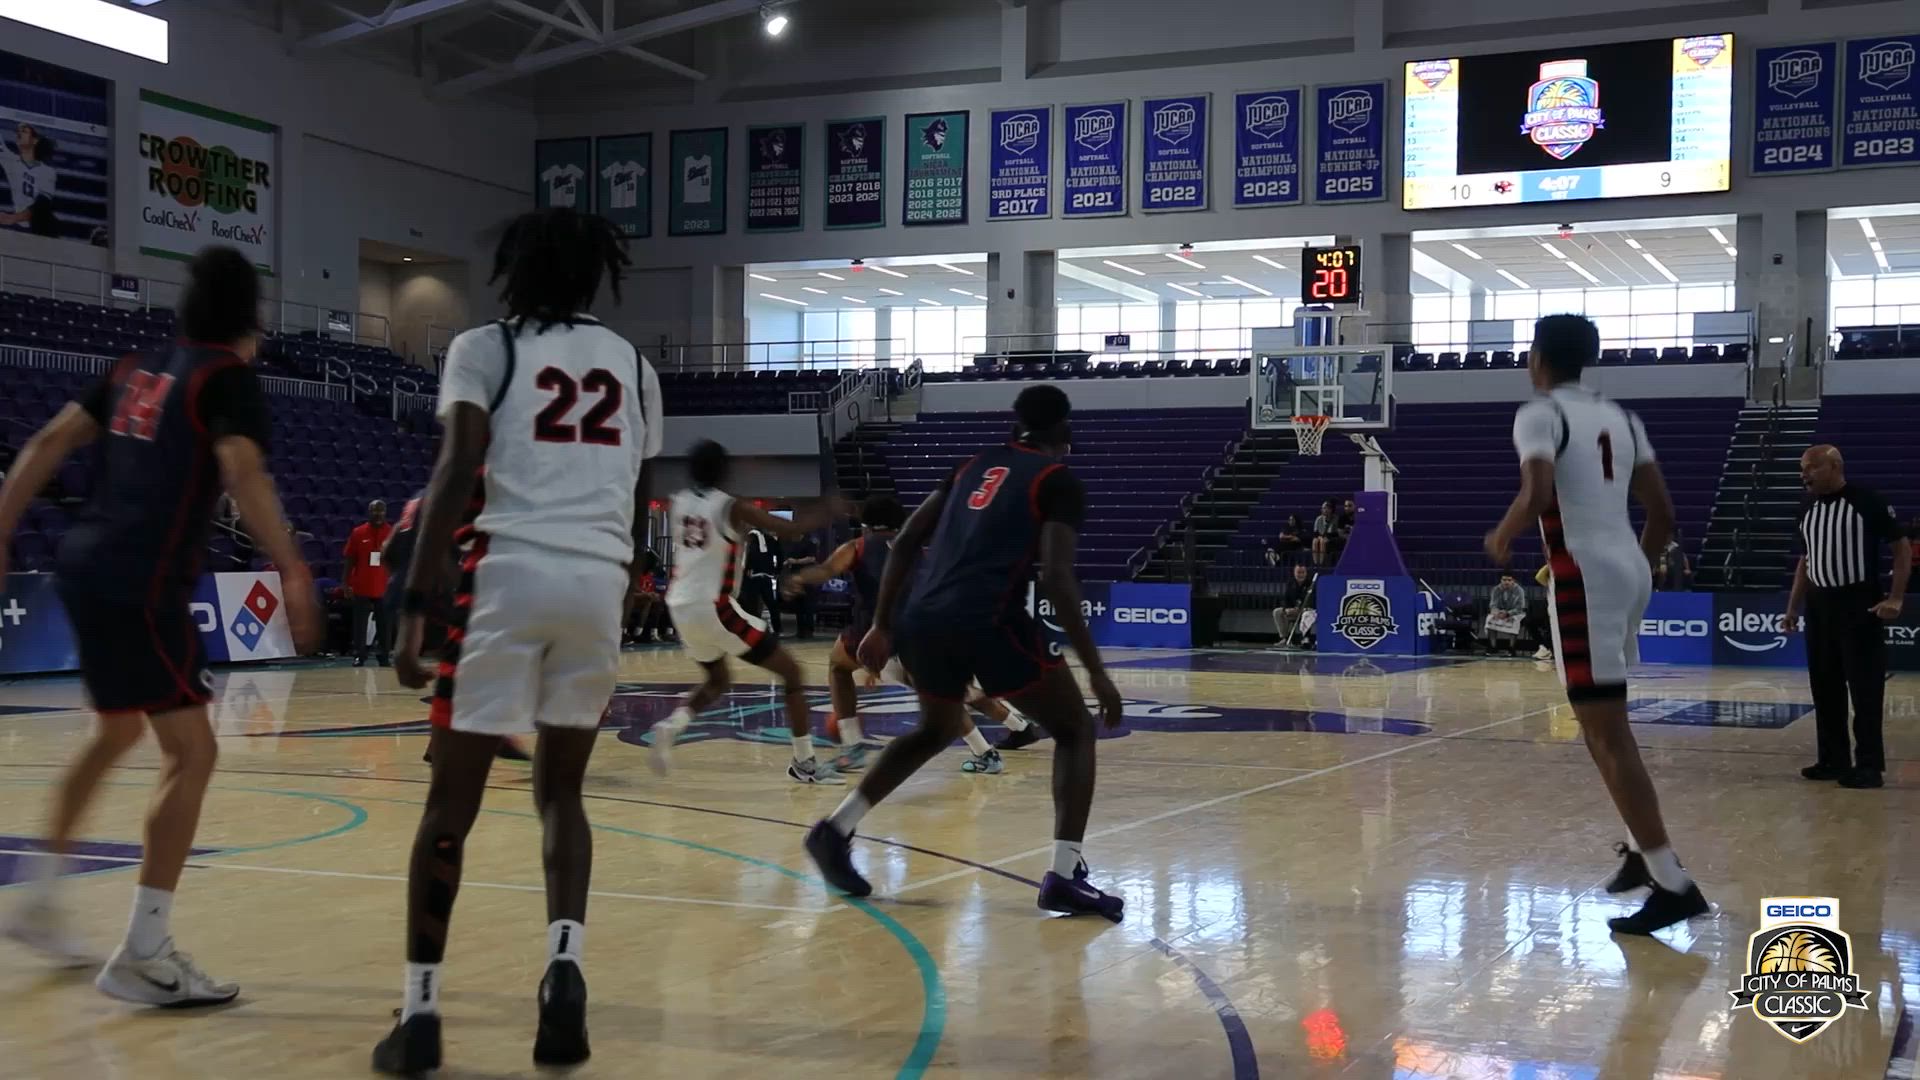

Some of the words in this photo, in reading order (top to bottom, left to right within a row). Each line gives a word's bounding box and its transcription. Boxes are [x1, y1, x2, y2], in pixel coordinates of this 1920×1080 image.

[1859, 49, 1915, 79] NJCAA
[1769, 57, 1822, 87] NJCAA
[1860, 93, 1912, 103] VOLLEYBALL
[1328, 97, 1372, 123] NJCAA
[1769, 101, 1820, 111] VOLLEYBALL
[1853, 106, 1918, 121] NATIONAL
[1154, 109, 1195, 134] NJCAA
[1247, 103, 1288, 129] NJCAA
[1763, 114, 1825, 129] NATIONAL
[1001, 121, 1039, 145] NJCAA
[1075, 116, 1114, 141] NJCAA
[1536, 124, 1590, 140] CLASSIC
[1758, 127, 1830, 142] CHAMPIONS
[1847, 119, 1920, 135] CHAMPIONS
[1251, 142, 1283, 150] SOFTBALL
[1333, 136, 1367, 145] SOFTBALL
[1854, 138, 1914, 157] 2023
[1079, 154, 1109, 162] SOFTBALL
[1158, 148, 1190, 156] SOFTBALL
[1325, 148, 1376, 161] NATIONAL
[1407, 153, 1417, 161] 22
[1674, 152, 1686, 161] 21
[1764, 145, 1823, 164] 2024
[139, 133, 270, 190] CROWTHER
[1005, 158, 1034, 166] SOFTBALL
[1150, 159, 1198, 171] NATIONAL
[1242, 153, 1292, 167] NATIONAL
[1320, 159, 1381, 173] RUNNER-UP
[999, 166, 1040, 177] NATIONAL
[1071, 166, 1117, 177] NATIONAL
[1145, 169, 1202, 182] CHAMPIONS
[1238, 164, 1297, 178] CHAMPIONS
[908, 178, 934, 188] 2016
[936, 177, 962, 187] 2017
[992, 176, 1047, 187] TOURNAMENT
[1066, 176, 1121, 188] CHAMPIONS
[1325, 176, 1374, 193] 2025
[1661, 171, 1671, 187] 9
[149, 167, 257, 214] ROOFING
[829, 183, 853, 193] 2017
[856, 181, 880, 191] 2018
[908, 189, 934, 199] 2018
[936, 188, 962, 198] 2021
[992, 189, 1012, 199] 3RD
[1013, 187, 1045, 198] PLACE
[1151, 186, 1196, 202] 2022
[1243, 180, 1290, 197] 2023
[1450, 184, 1471, 200] 10
[829, 193, 853, 203] 2023
[856, 192, 879, 202] 2025
[908, 199, 934, 209] 2022
[936, 198, 962, 208] 2023
[1073, 192, 1114, 207] 2021
[908, 209, 934, 219] 2024
[936, 208, 962, 218] 2025
[999, 199, 1038, 214] 2017
[1316, 250, 1355, 268] 4:07
[1312, 269, 1347, 298] 20
[534, 365, 622, 446] 22
[1597, 430, 1614, 482] 1
[966, 466, 1010, 510] 3
[1114, 607, 1188, 624] GEICO
[1340, 616, 1358, 626] CITY
[1358, 614, 1369, 624] OF
[1347, 625, 1381, 636] CLASSIC
[1639, 618, 1709, 637] EICO
